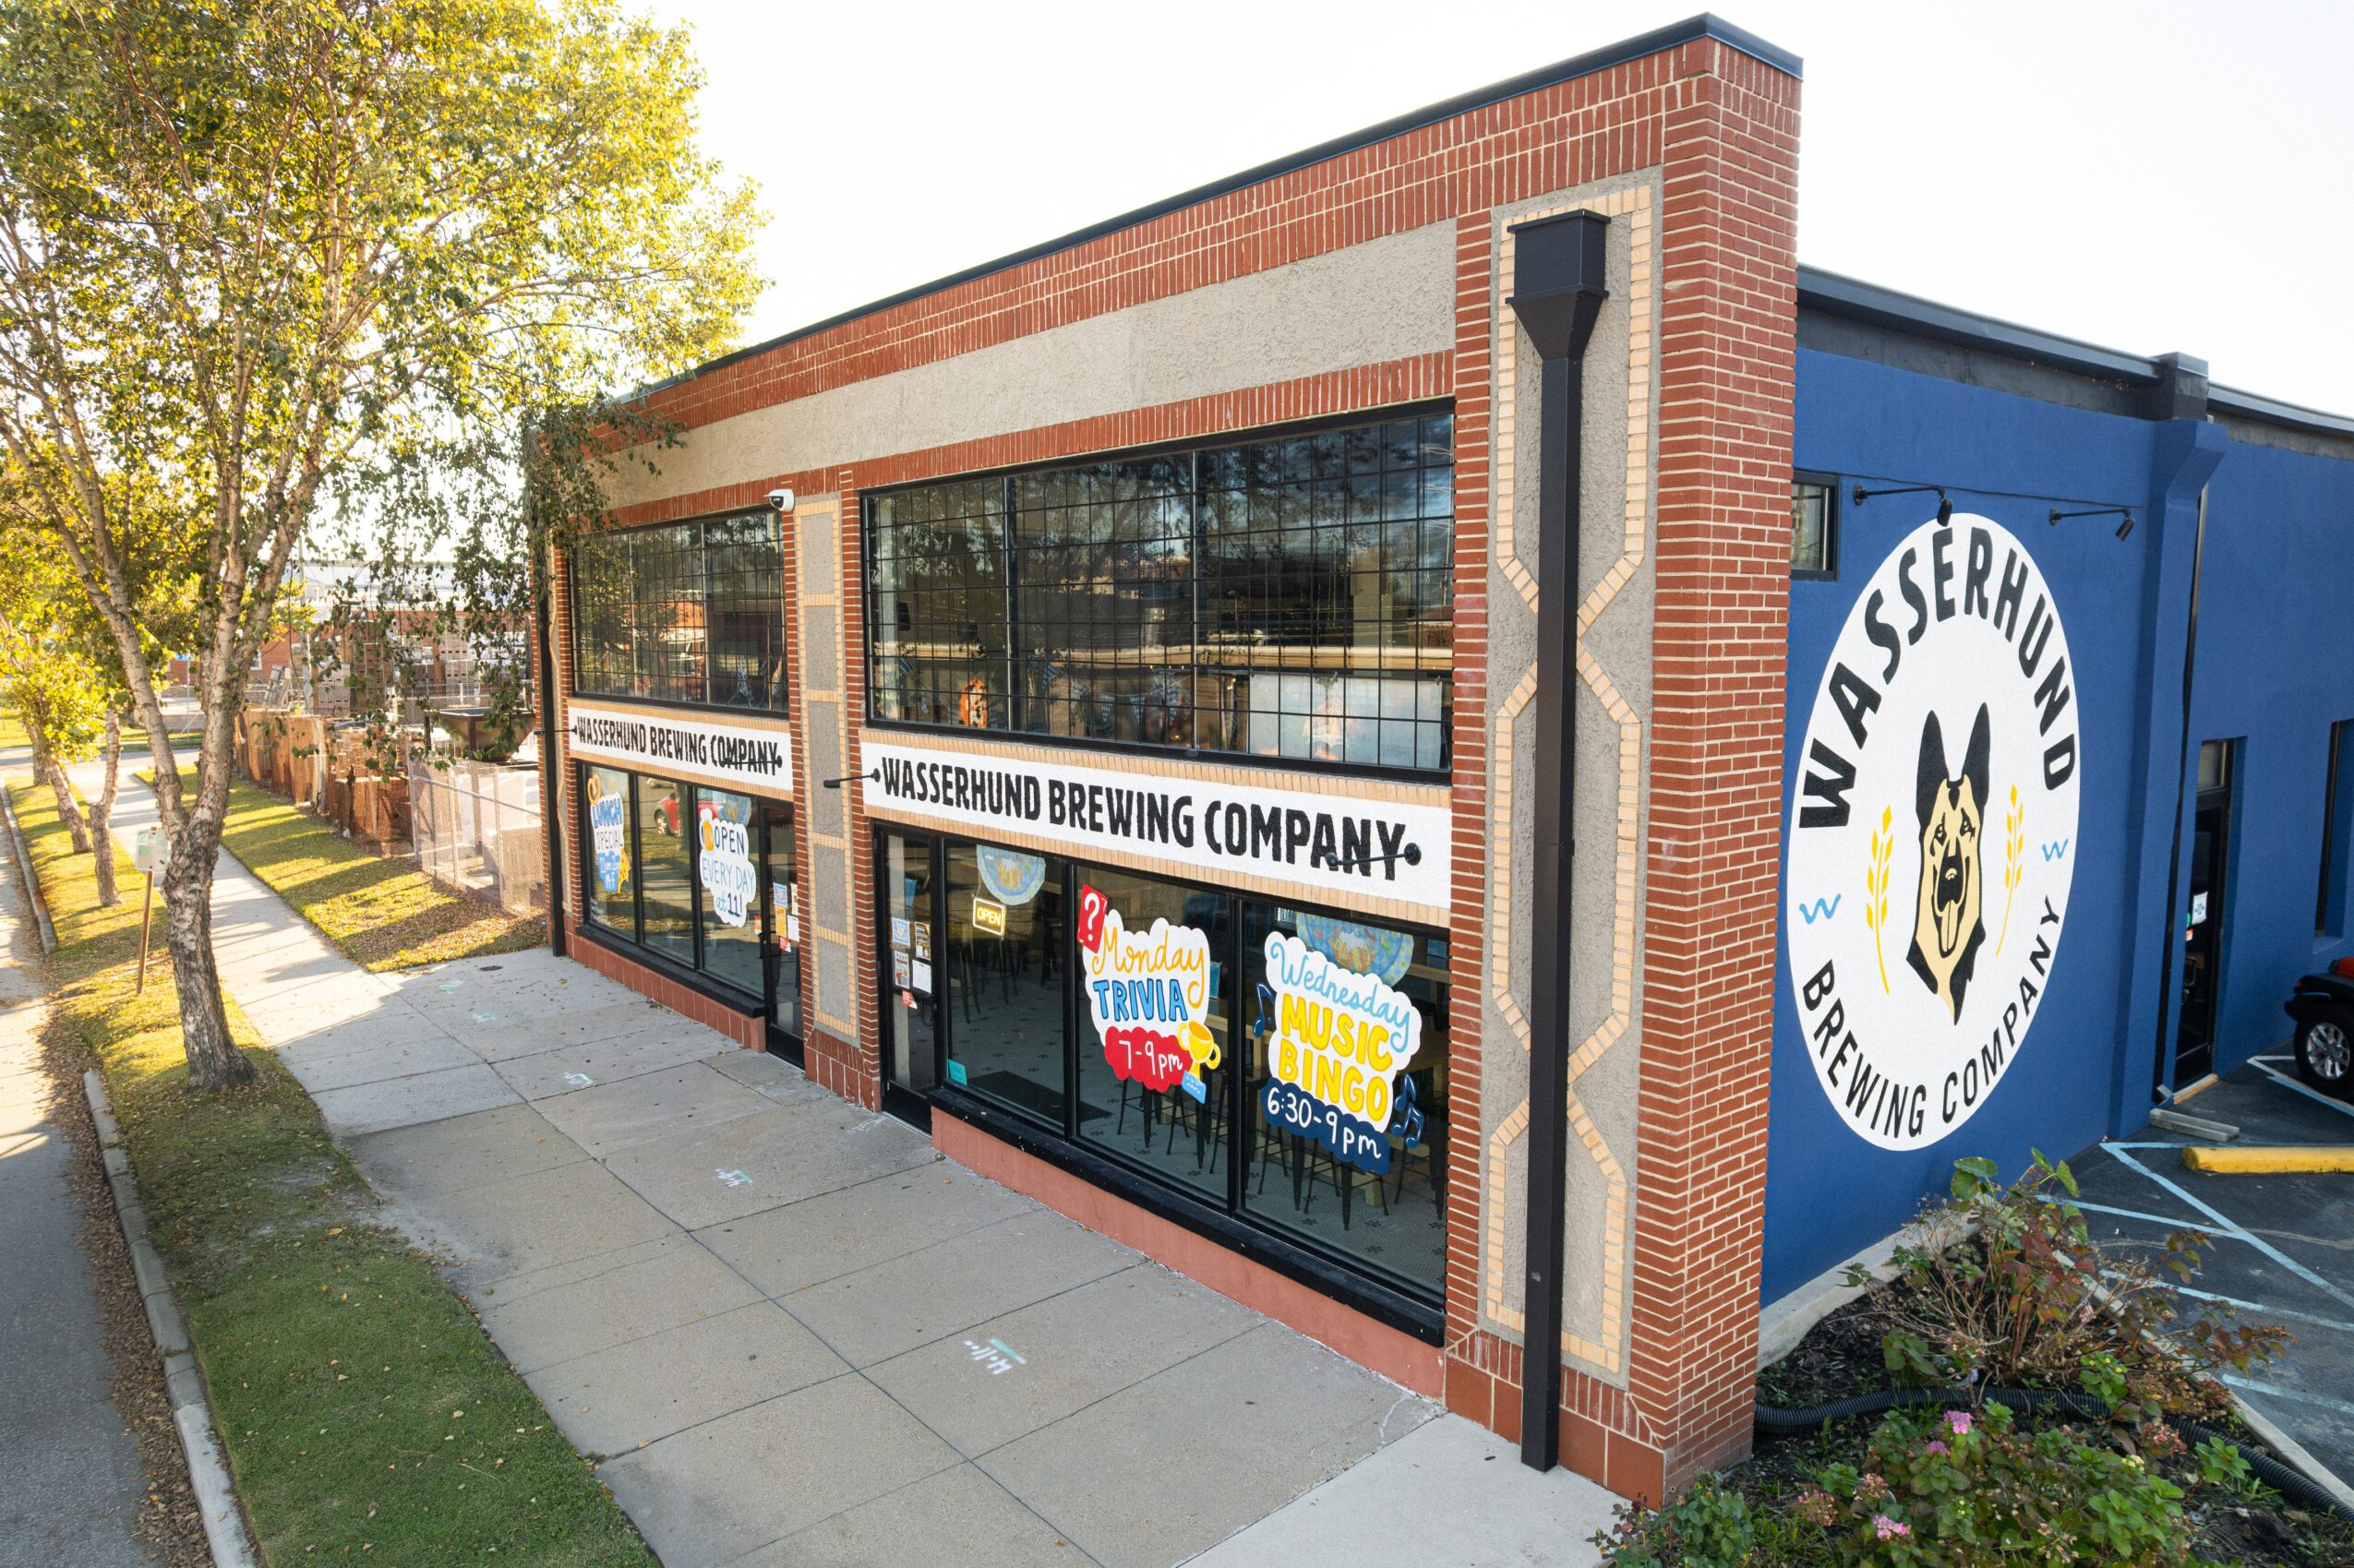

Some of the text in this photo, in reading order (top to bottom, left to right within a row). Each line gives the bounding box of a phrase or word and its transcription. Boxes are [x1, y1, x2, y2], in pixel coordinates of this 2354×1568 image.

[1799, 526, 2075, 829] WASSERHUND
[577, 716, 778, 776] WASSERHUND BREWING COMPANY
[592, 797, 623, 829] LUNCH
[595, 829, 624, 851] SPECIAL
[714, 825, 745, 856] OPEN
[881, 756, 1407, 881] WASSERHUND BREWING COMPANY
[702, 857, 731, 888] EVERY
[735, 866, 755, 895] DAY
[977, 907, 1002, 926] OPEN
[1092, 926, 1206, 1010] Monday
[1092, 977, 1189, 1023] TRIVIA
[1269, 940, 1411, 1054] Wednesday
[1280, 993, 1393, 1072] MUSIC
[1802, 893, 2060, 1139] BREWING COMPANY
[1278, 1037, 1388, 1122] BINGO
